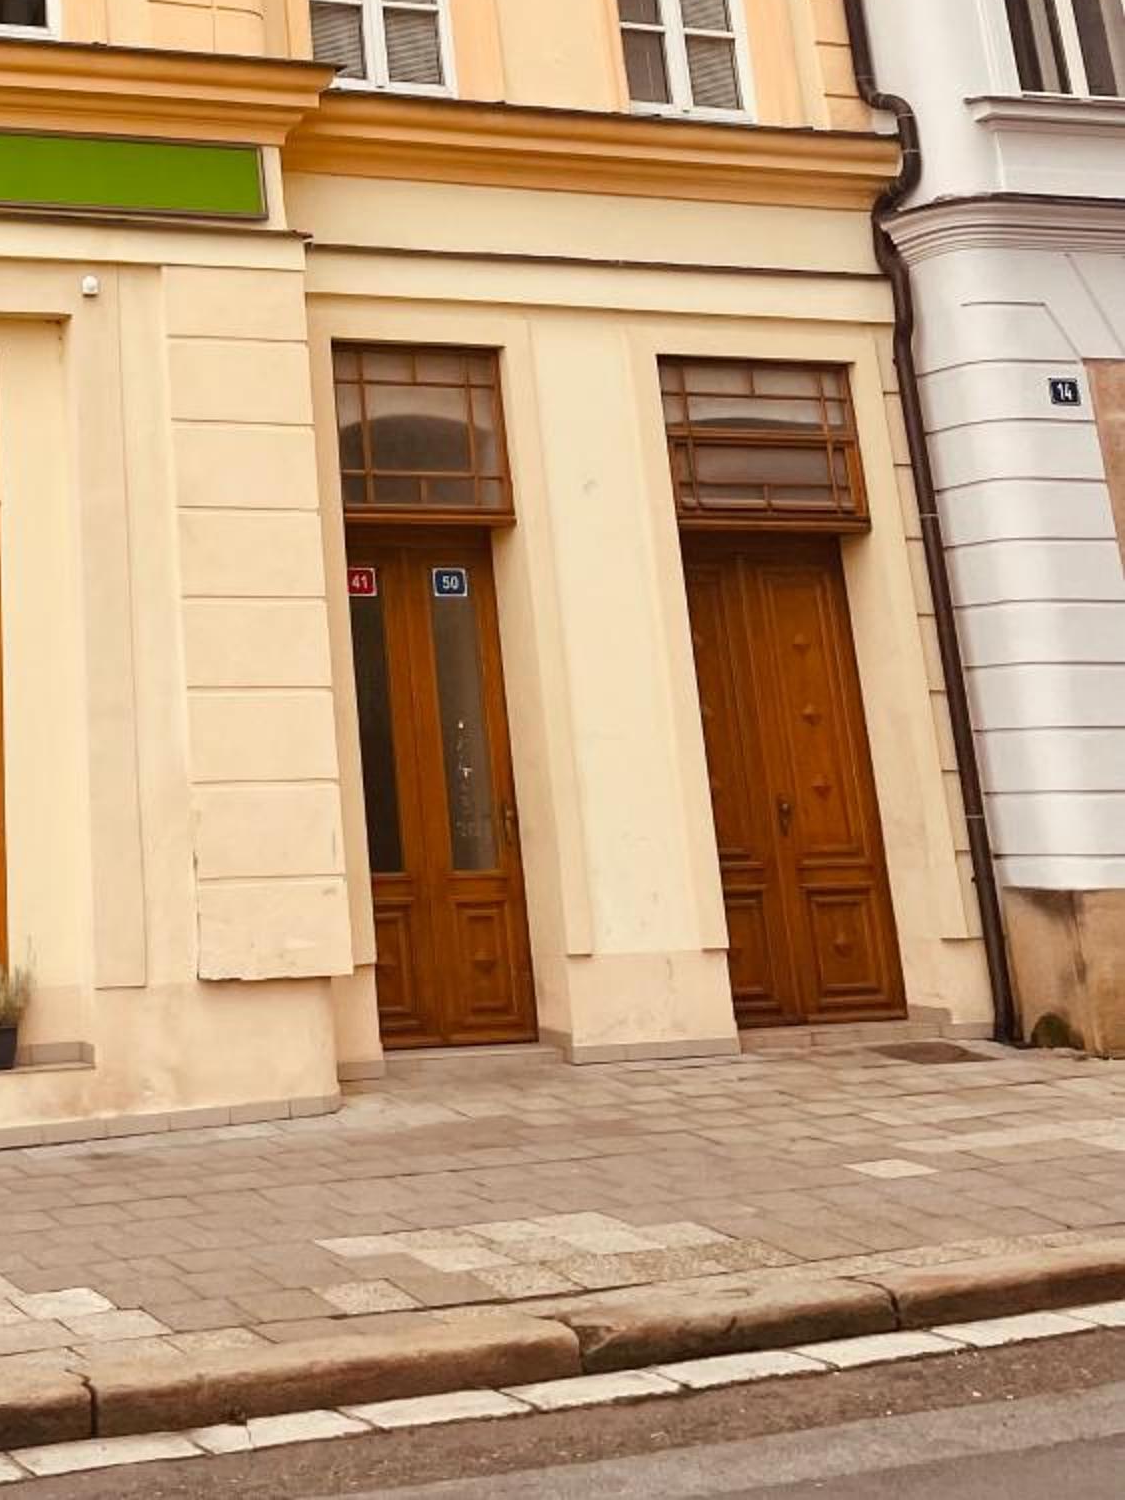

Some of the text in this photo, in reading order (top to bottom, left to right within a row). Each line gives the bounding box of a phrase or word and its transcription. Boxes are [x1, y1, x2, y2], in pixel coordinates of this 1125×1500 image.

[1057, 382, 1072, 400] 14
[351, 574, 367, 589] 41
[442, 575, 459, 589] 50
